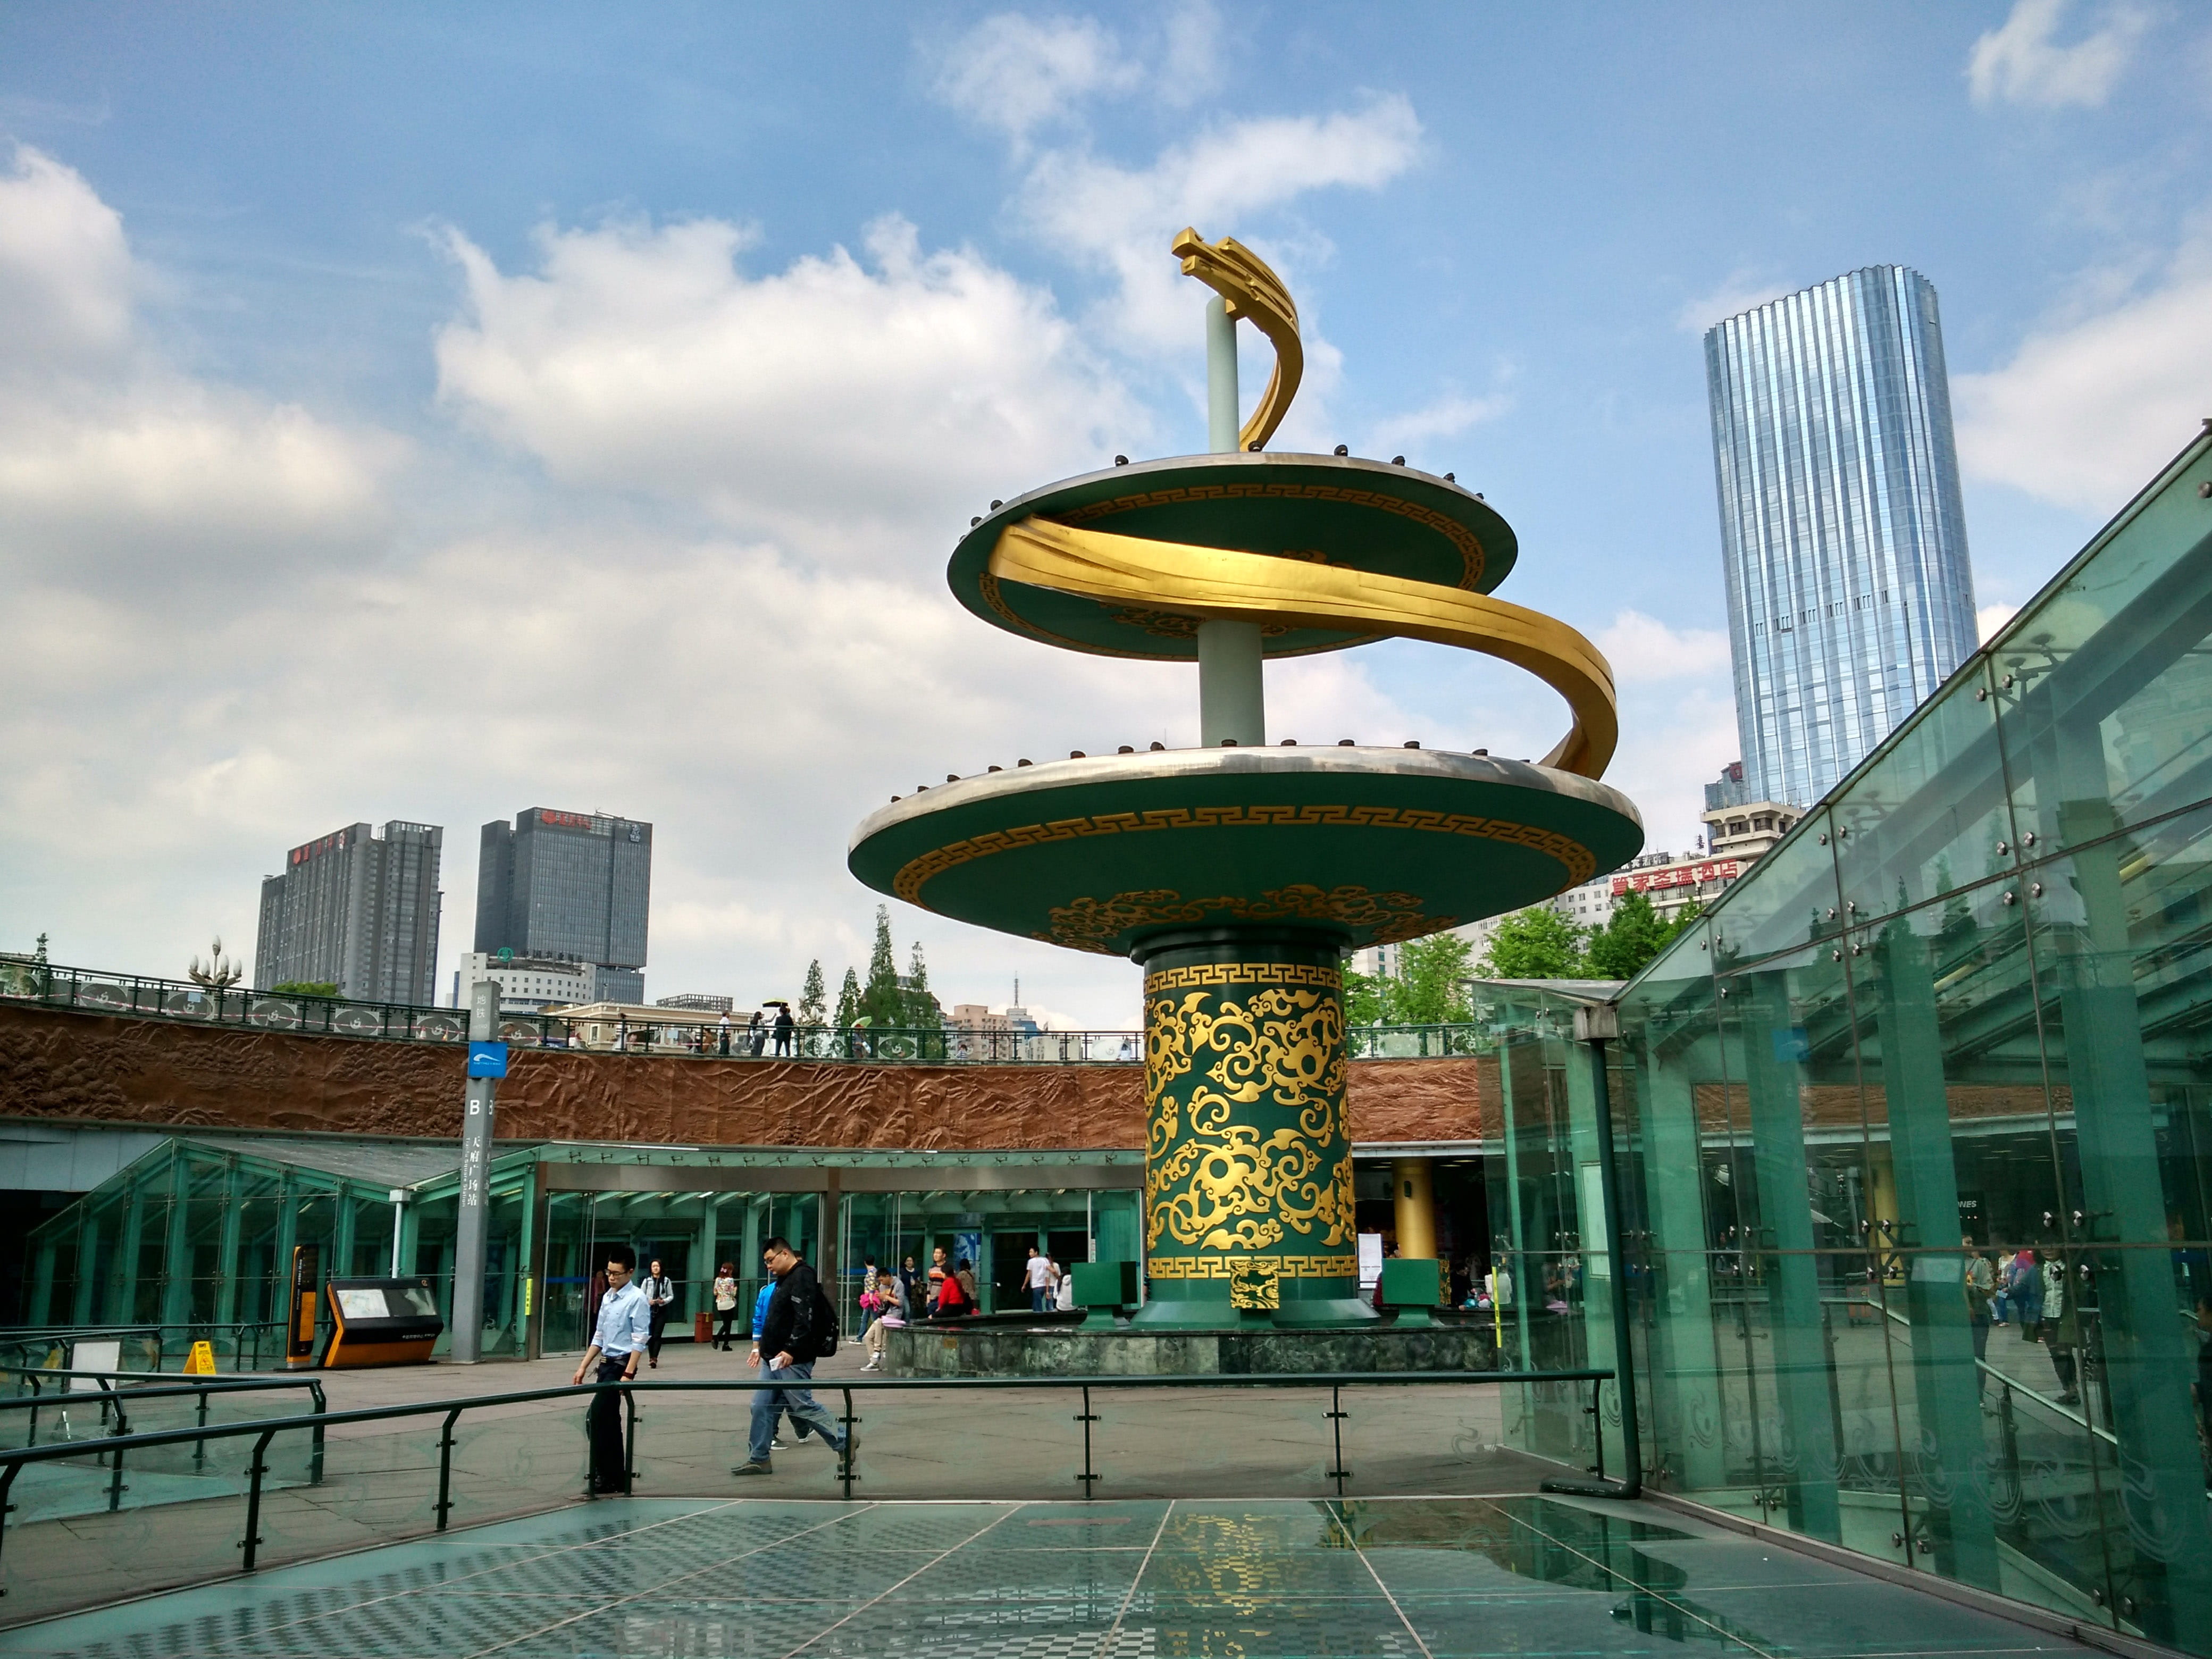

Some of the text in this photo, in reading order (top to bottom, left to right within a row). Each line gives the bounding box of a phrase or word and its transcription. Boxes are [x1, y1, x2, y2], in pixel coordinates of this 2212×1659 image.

[1612, 859, 1738, 896] 管家圣瑞酒店
[476, 994, 486, 1018] 地铁
[470, 1100, 480, 1115] B
[467, 1136, 480, 1206] 天府广场站
